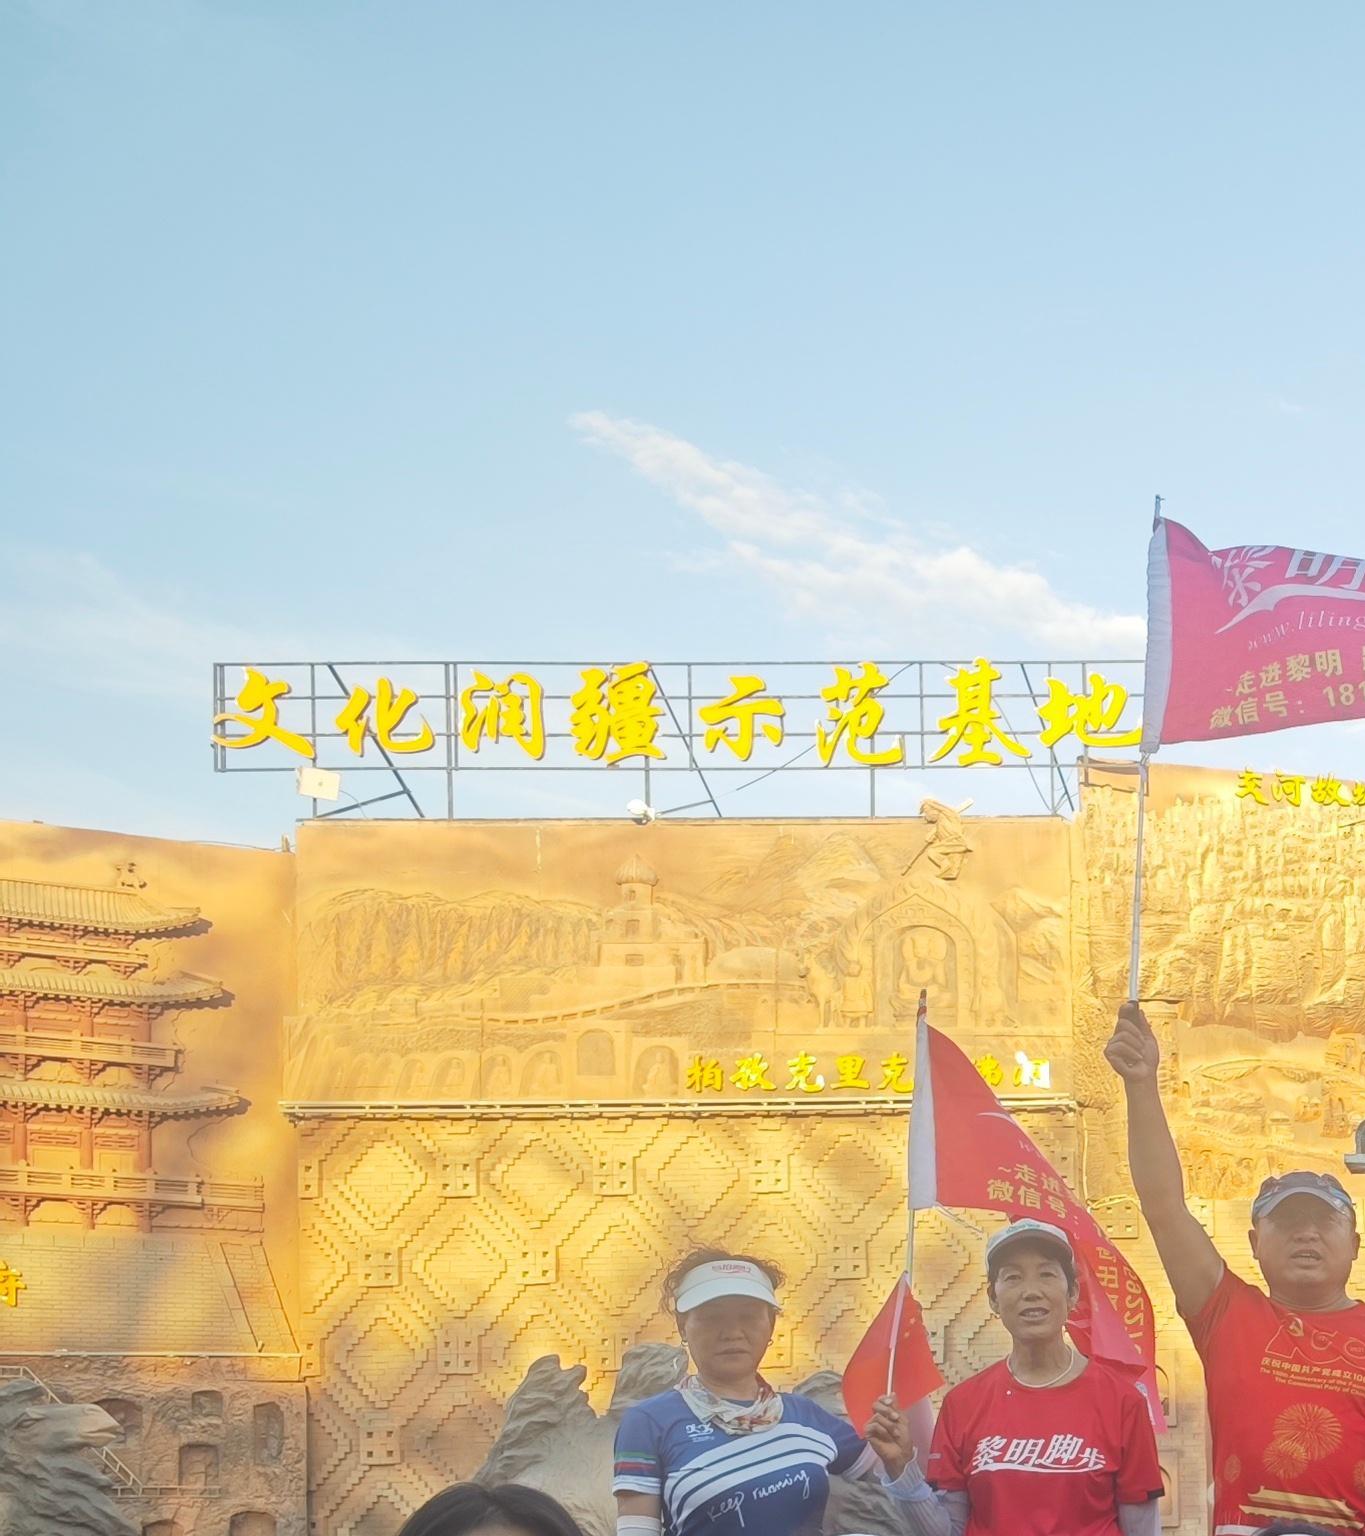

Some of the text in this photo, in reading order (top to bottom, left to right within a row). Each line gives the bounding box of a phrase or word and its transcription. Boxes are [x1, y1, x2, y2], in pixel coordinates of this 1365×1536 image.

[211, 656, 1149, 767] 文化润疆示范基地
[686, 1050, 1051, 1094] 柏孜克里克佛洞
[970, 1433, 1108, 1471] 黎明脚步
